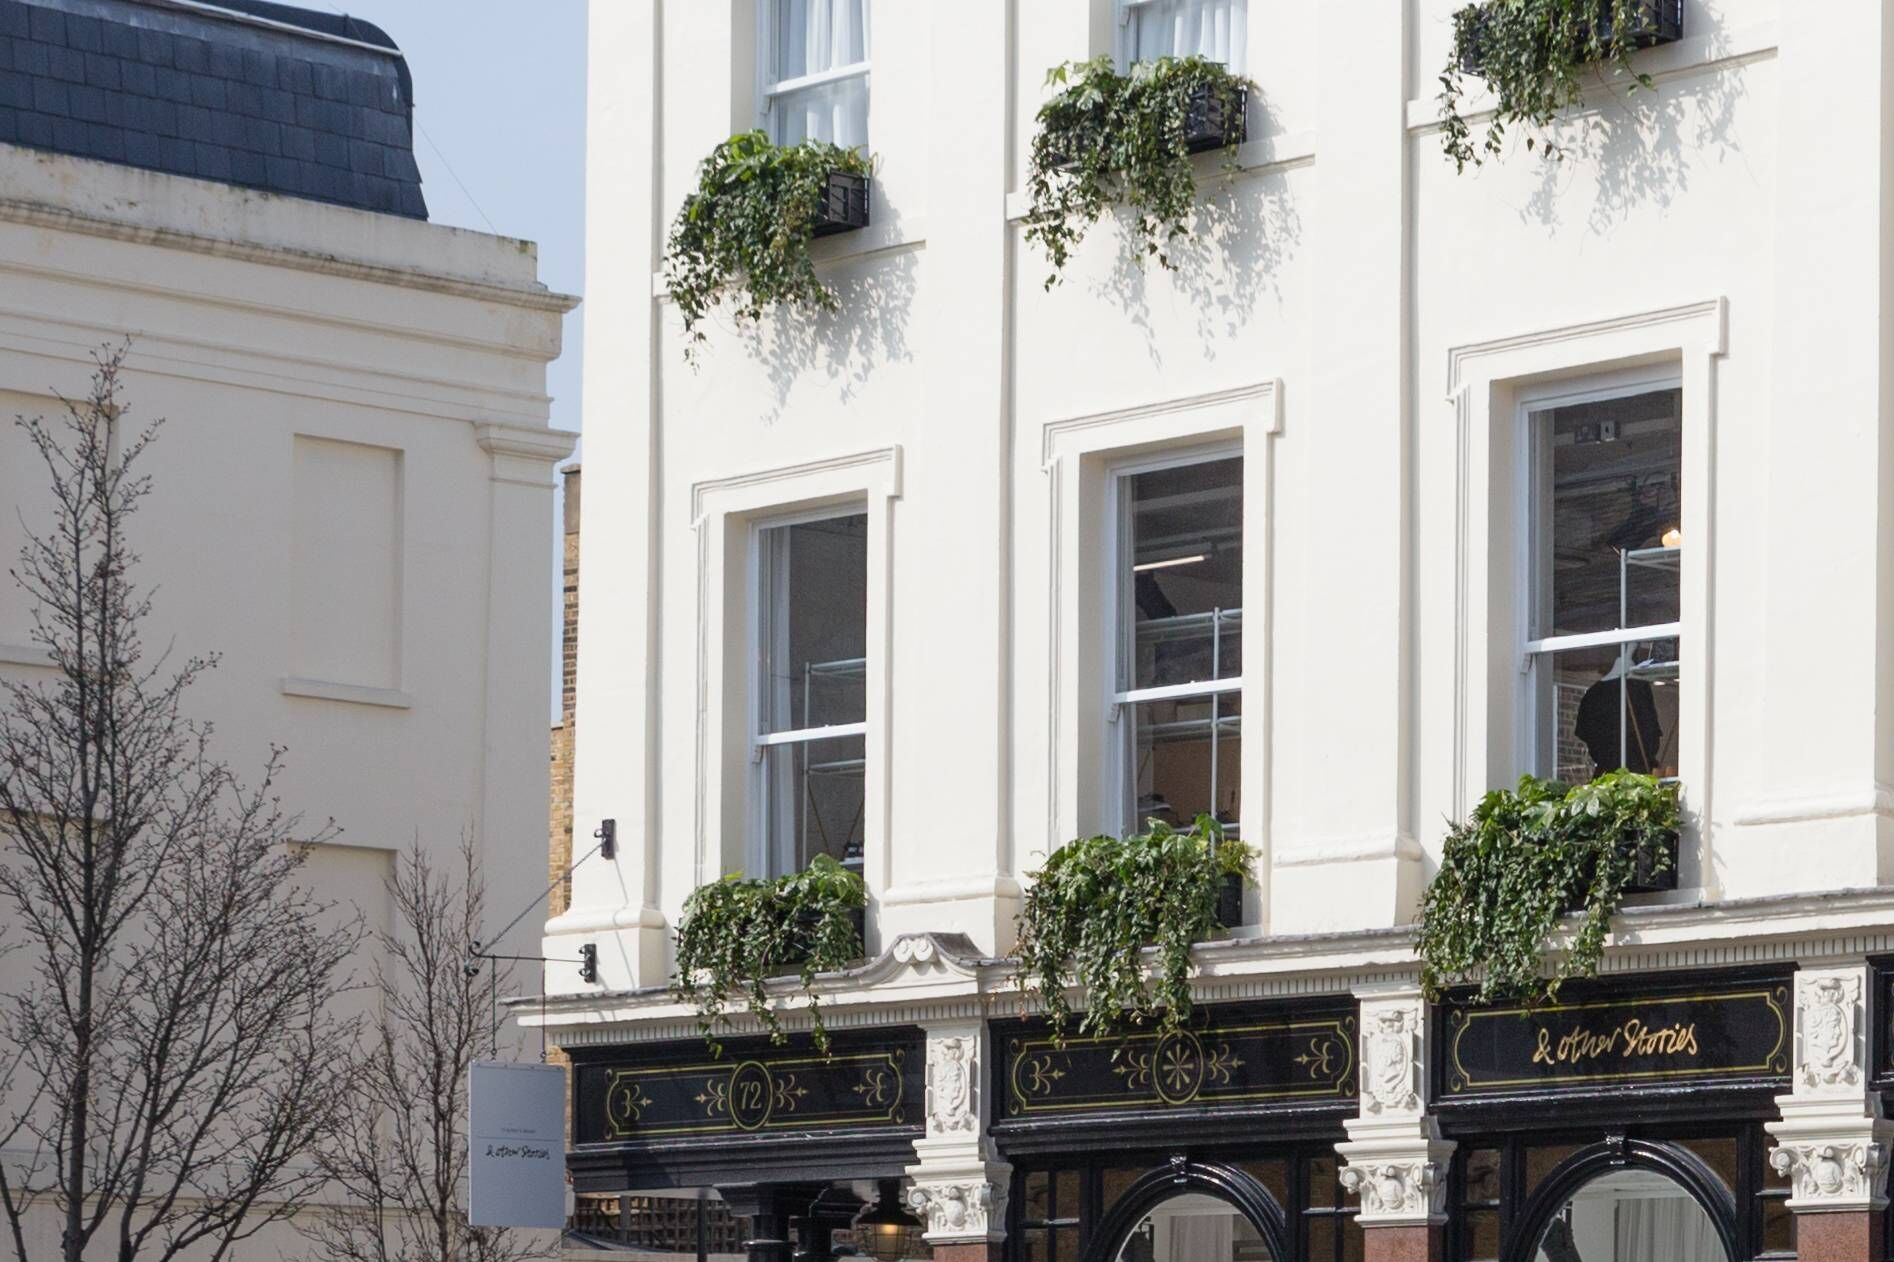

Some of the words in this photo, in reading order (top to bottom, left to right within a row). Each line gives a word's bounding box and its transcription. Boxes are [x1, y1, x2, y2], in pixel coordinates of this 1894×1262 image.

[1532, 1027, 1556, 1065] &
[1557, 1025, 1622, 1064] other
[1622, 1018, 1698, 1058] Stories
[740, 1081, 762, 1111] 72
